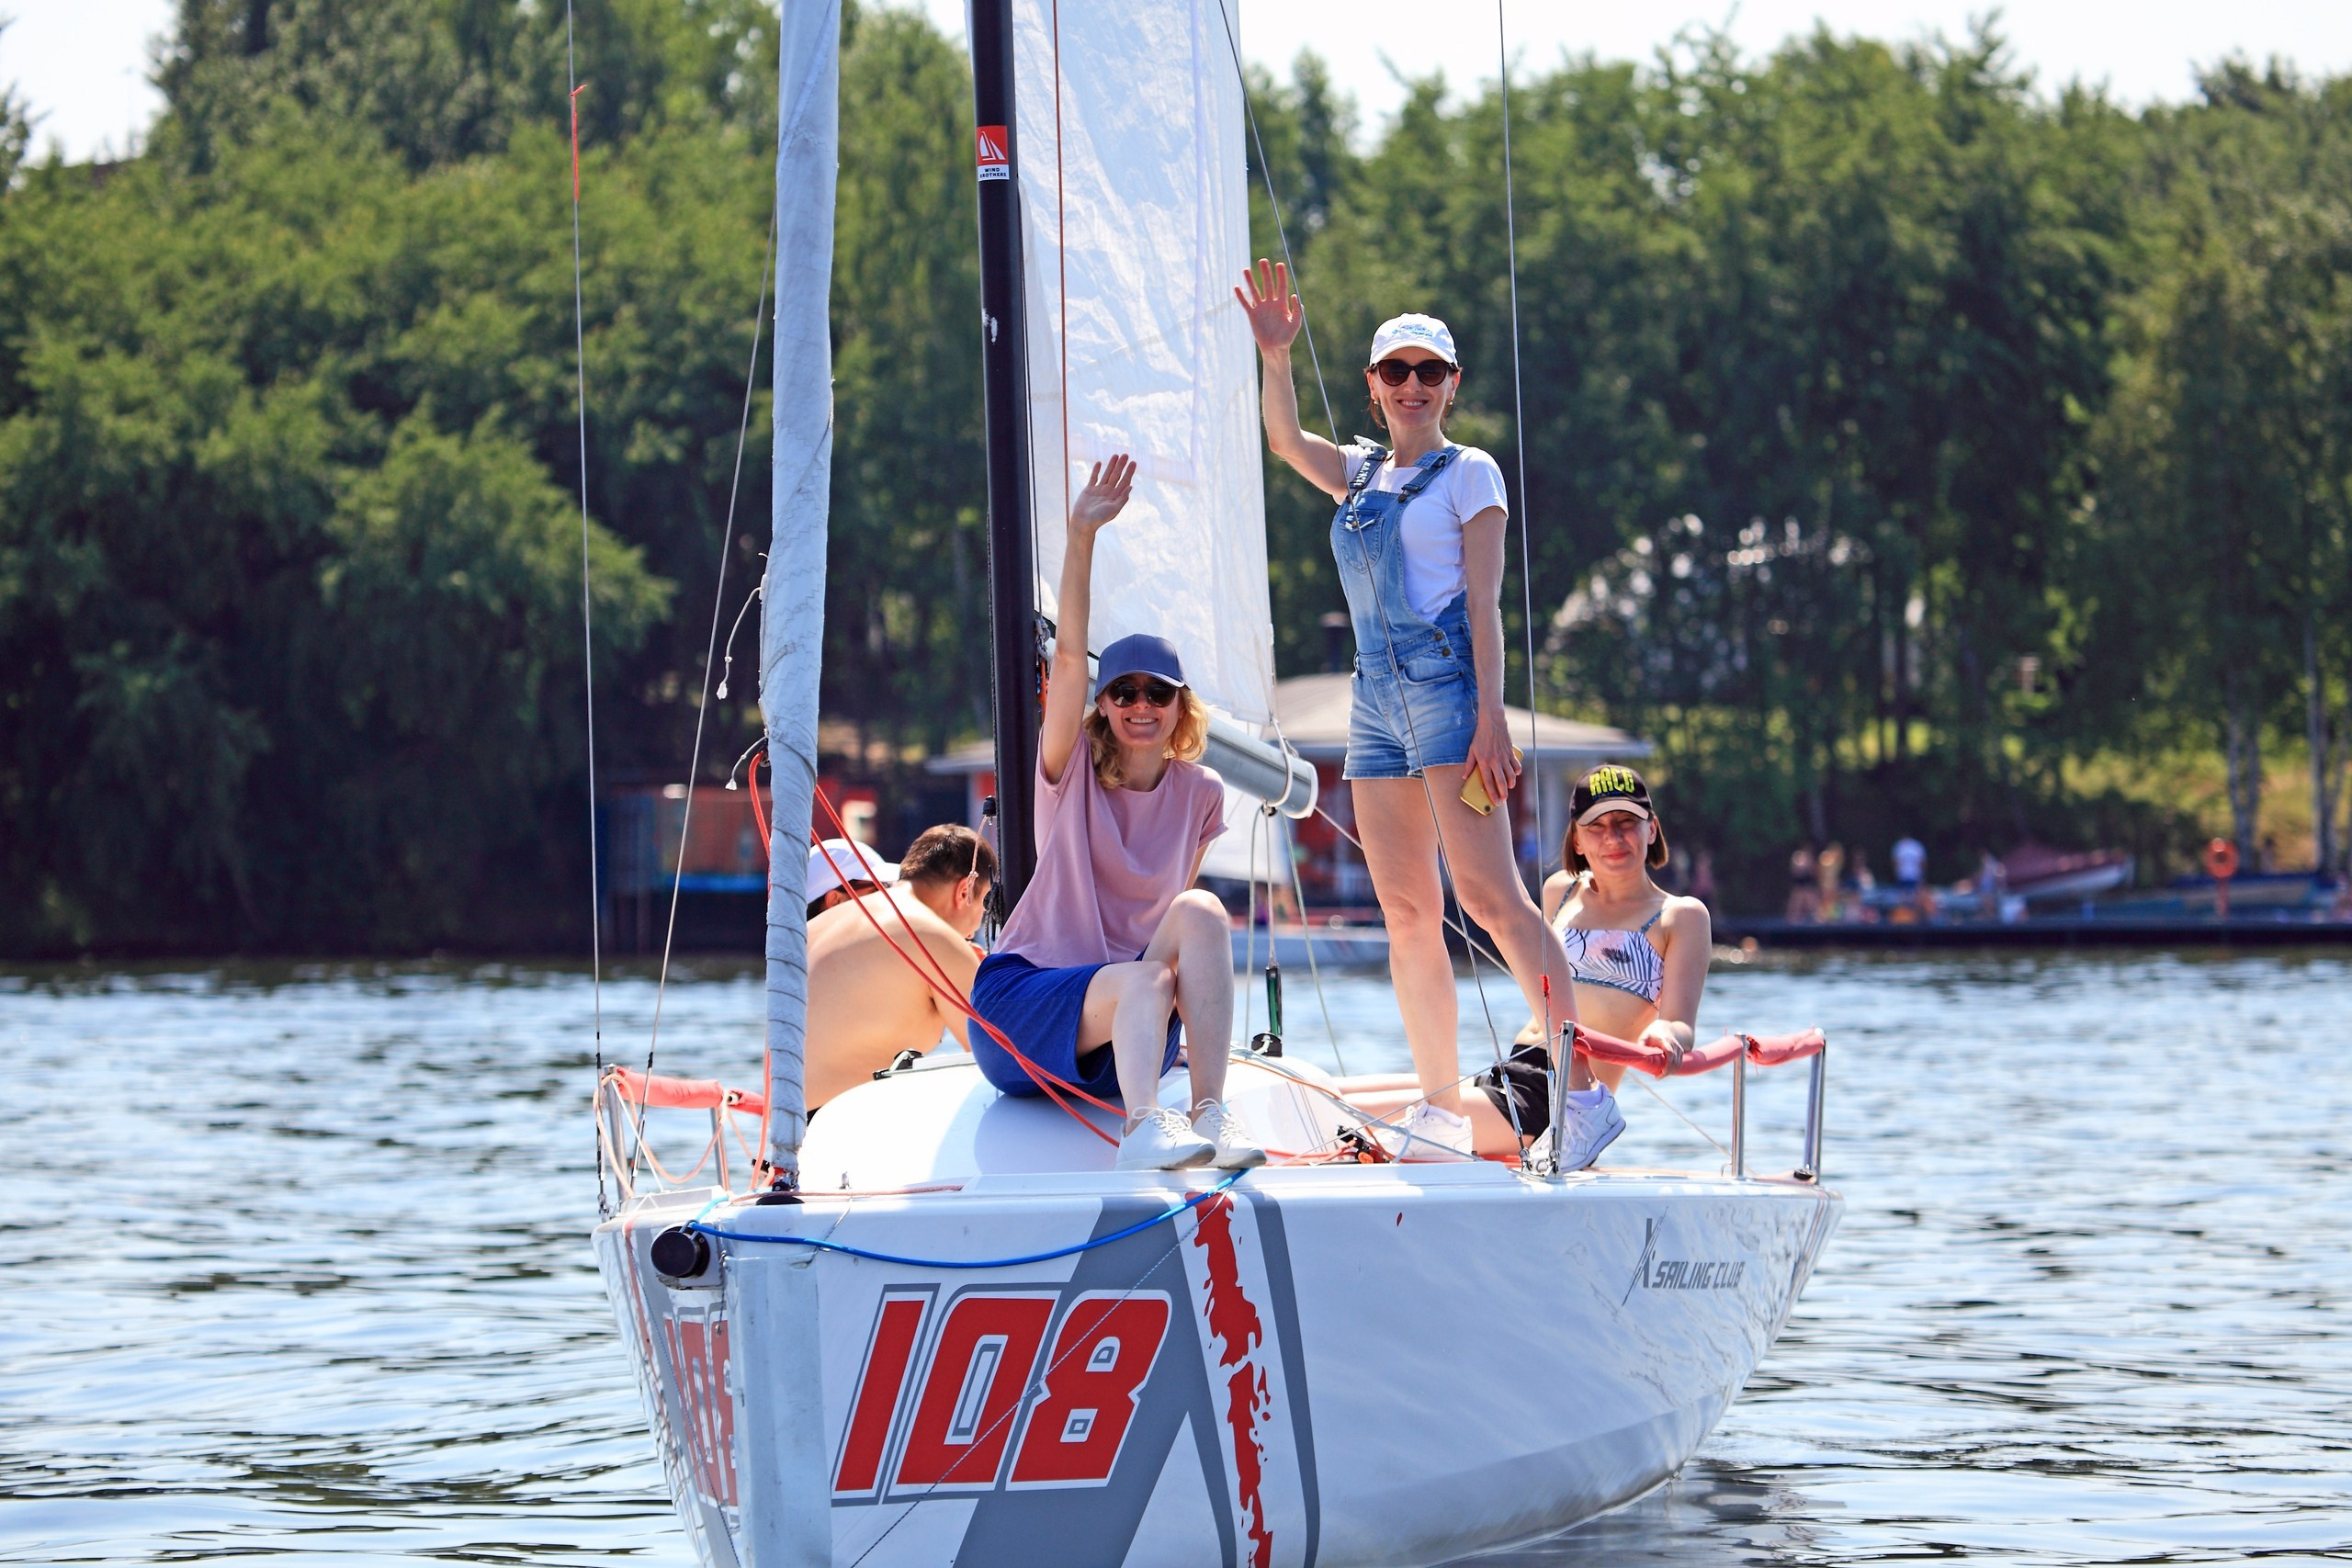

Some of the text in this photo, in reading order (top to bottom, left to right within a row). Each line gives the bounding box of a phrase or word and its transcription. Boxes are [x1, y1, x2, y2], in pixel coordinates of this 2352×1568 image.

[1652, 1261, 1715, 1290] SAILING
[1713, 1261, 1746, 1289] CLUB
[834, 1296, 1170, 1492] 108
